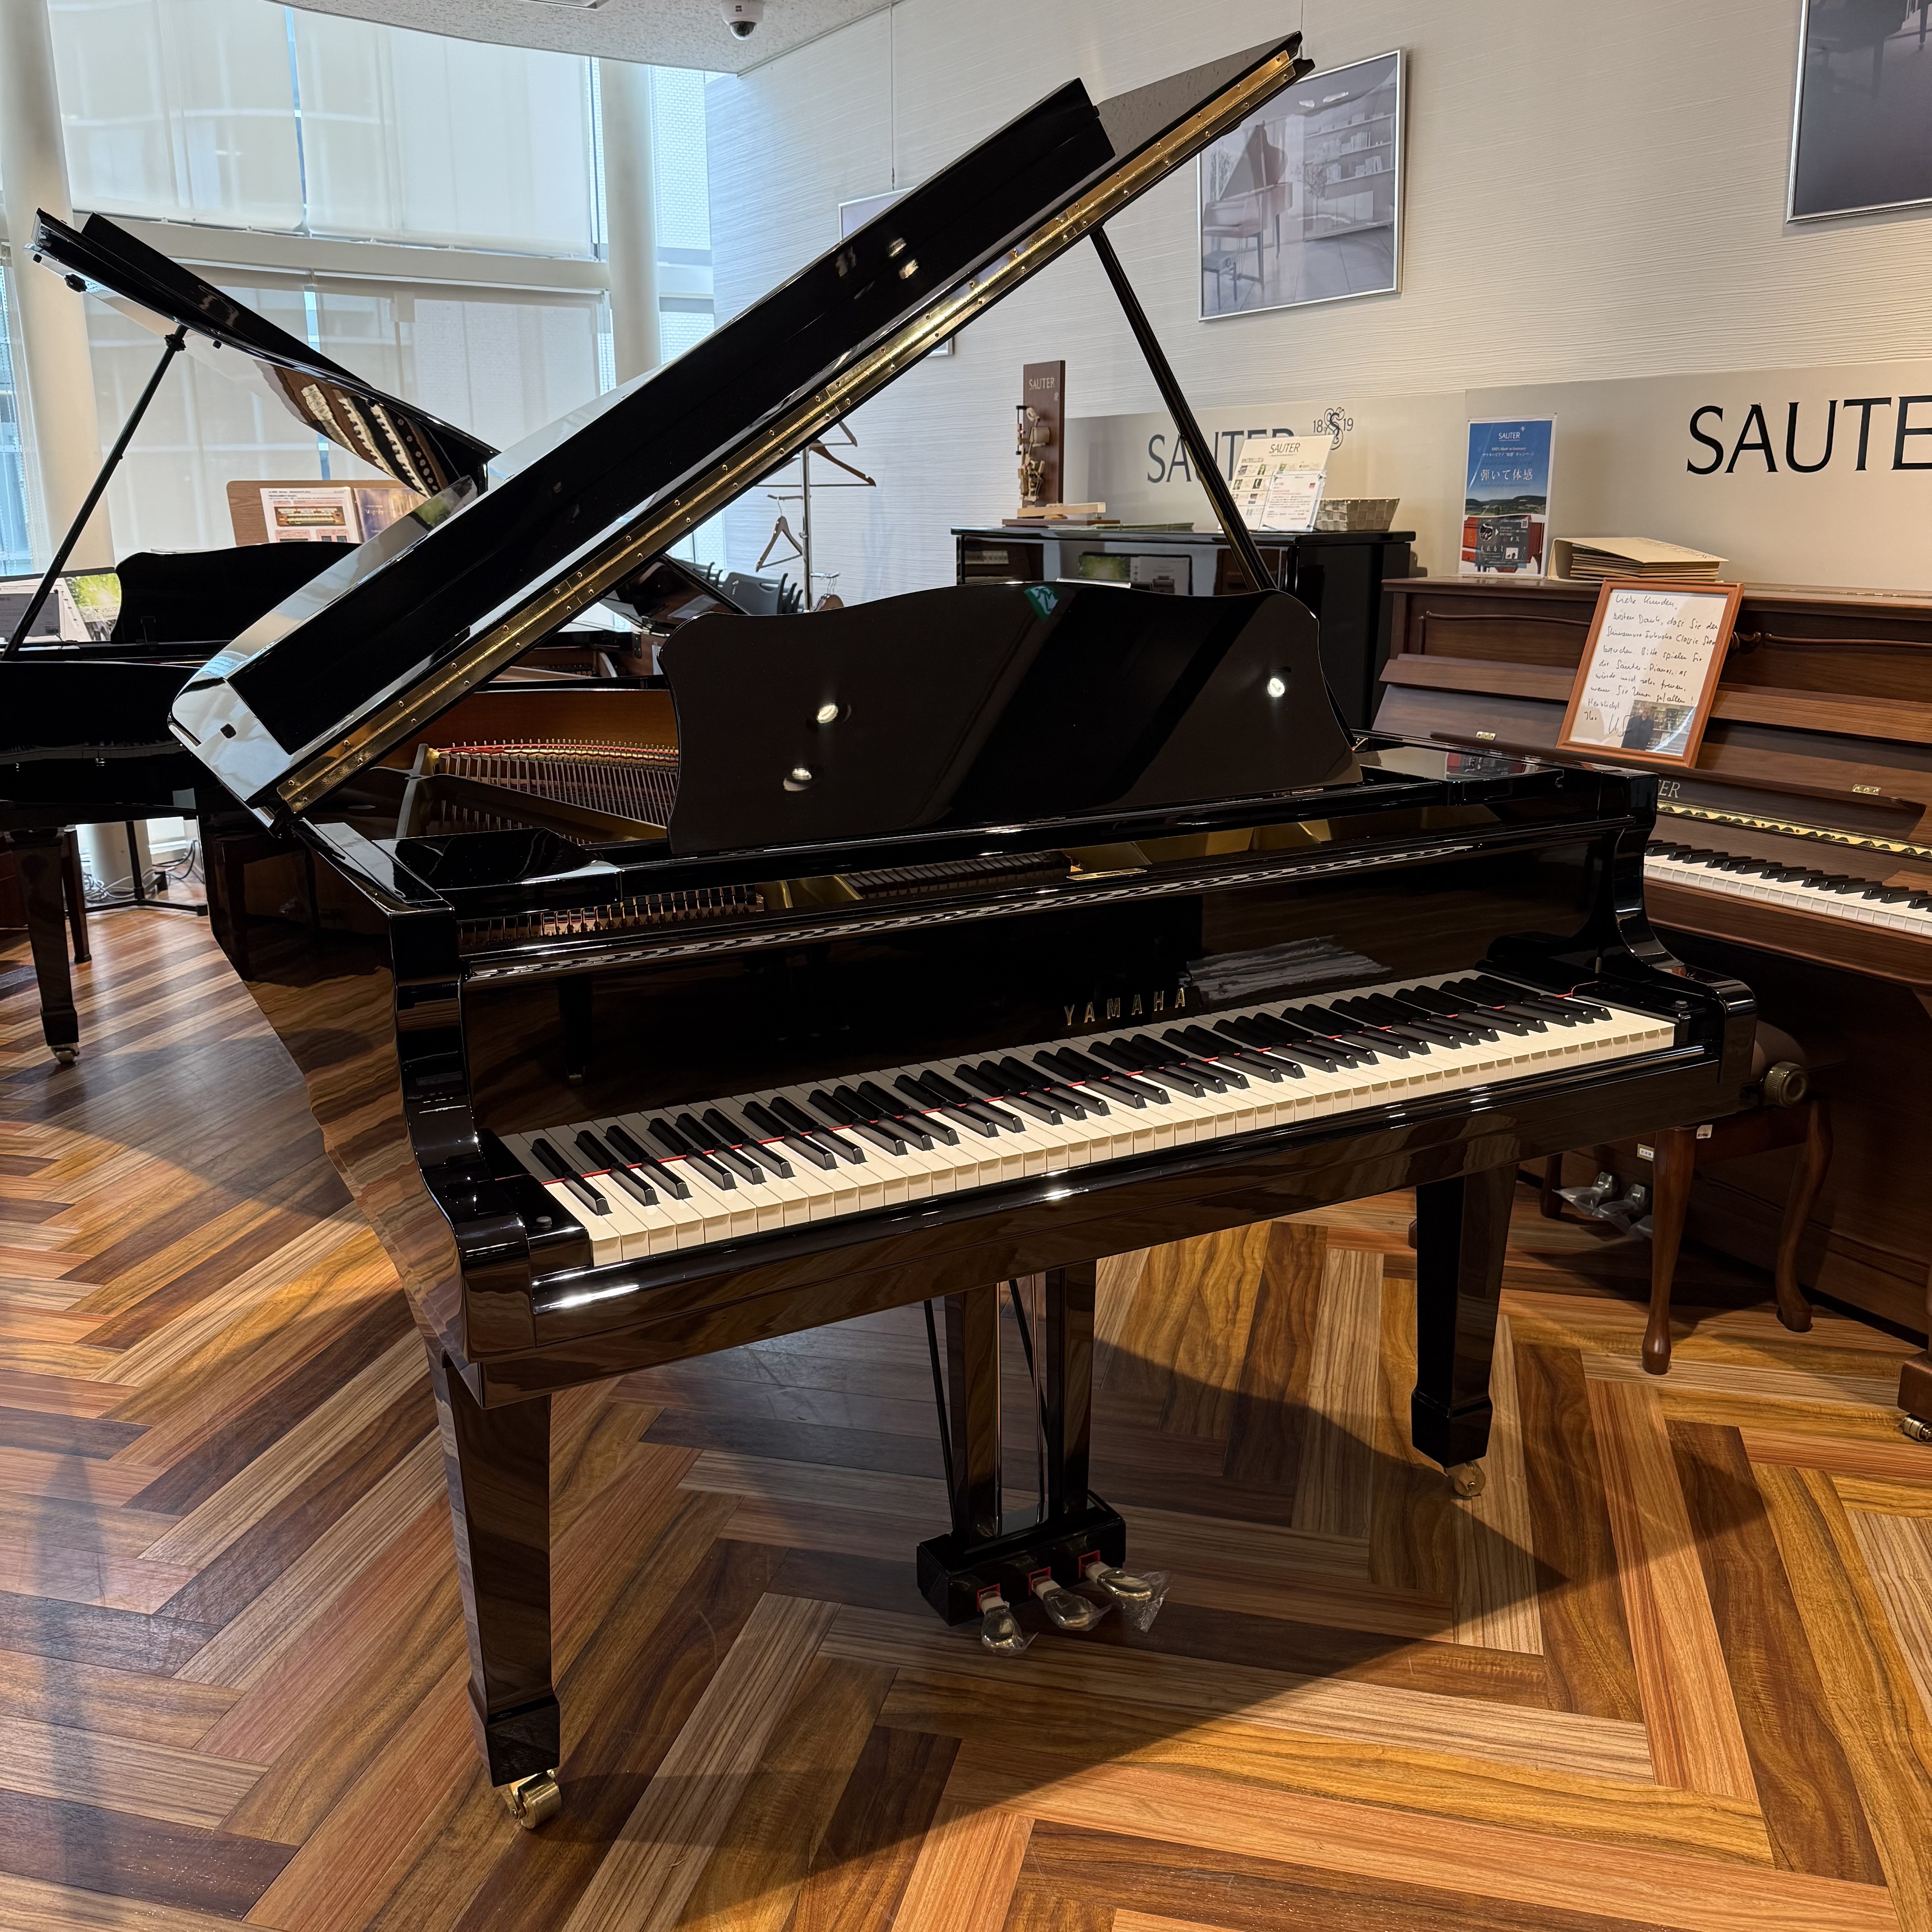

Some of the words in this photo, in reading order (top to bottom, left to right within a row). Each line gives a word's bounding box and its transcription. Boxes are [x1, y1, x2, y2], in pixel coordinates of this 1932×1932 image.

[1029, 377, 1055, 390] SAUTER
[1313, 419, 1323, 433] 18
[1343, 418, 1353, 431] 19
[1269, 442, 1301, 454] SAUTER
[1481, 469, 1533, 481] 弾いて体感
[1064, 987, 1186, 1026] YAMAHA
